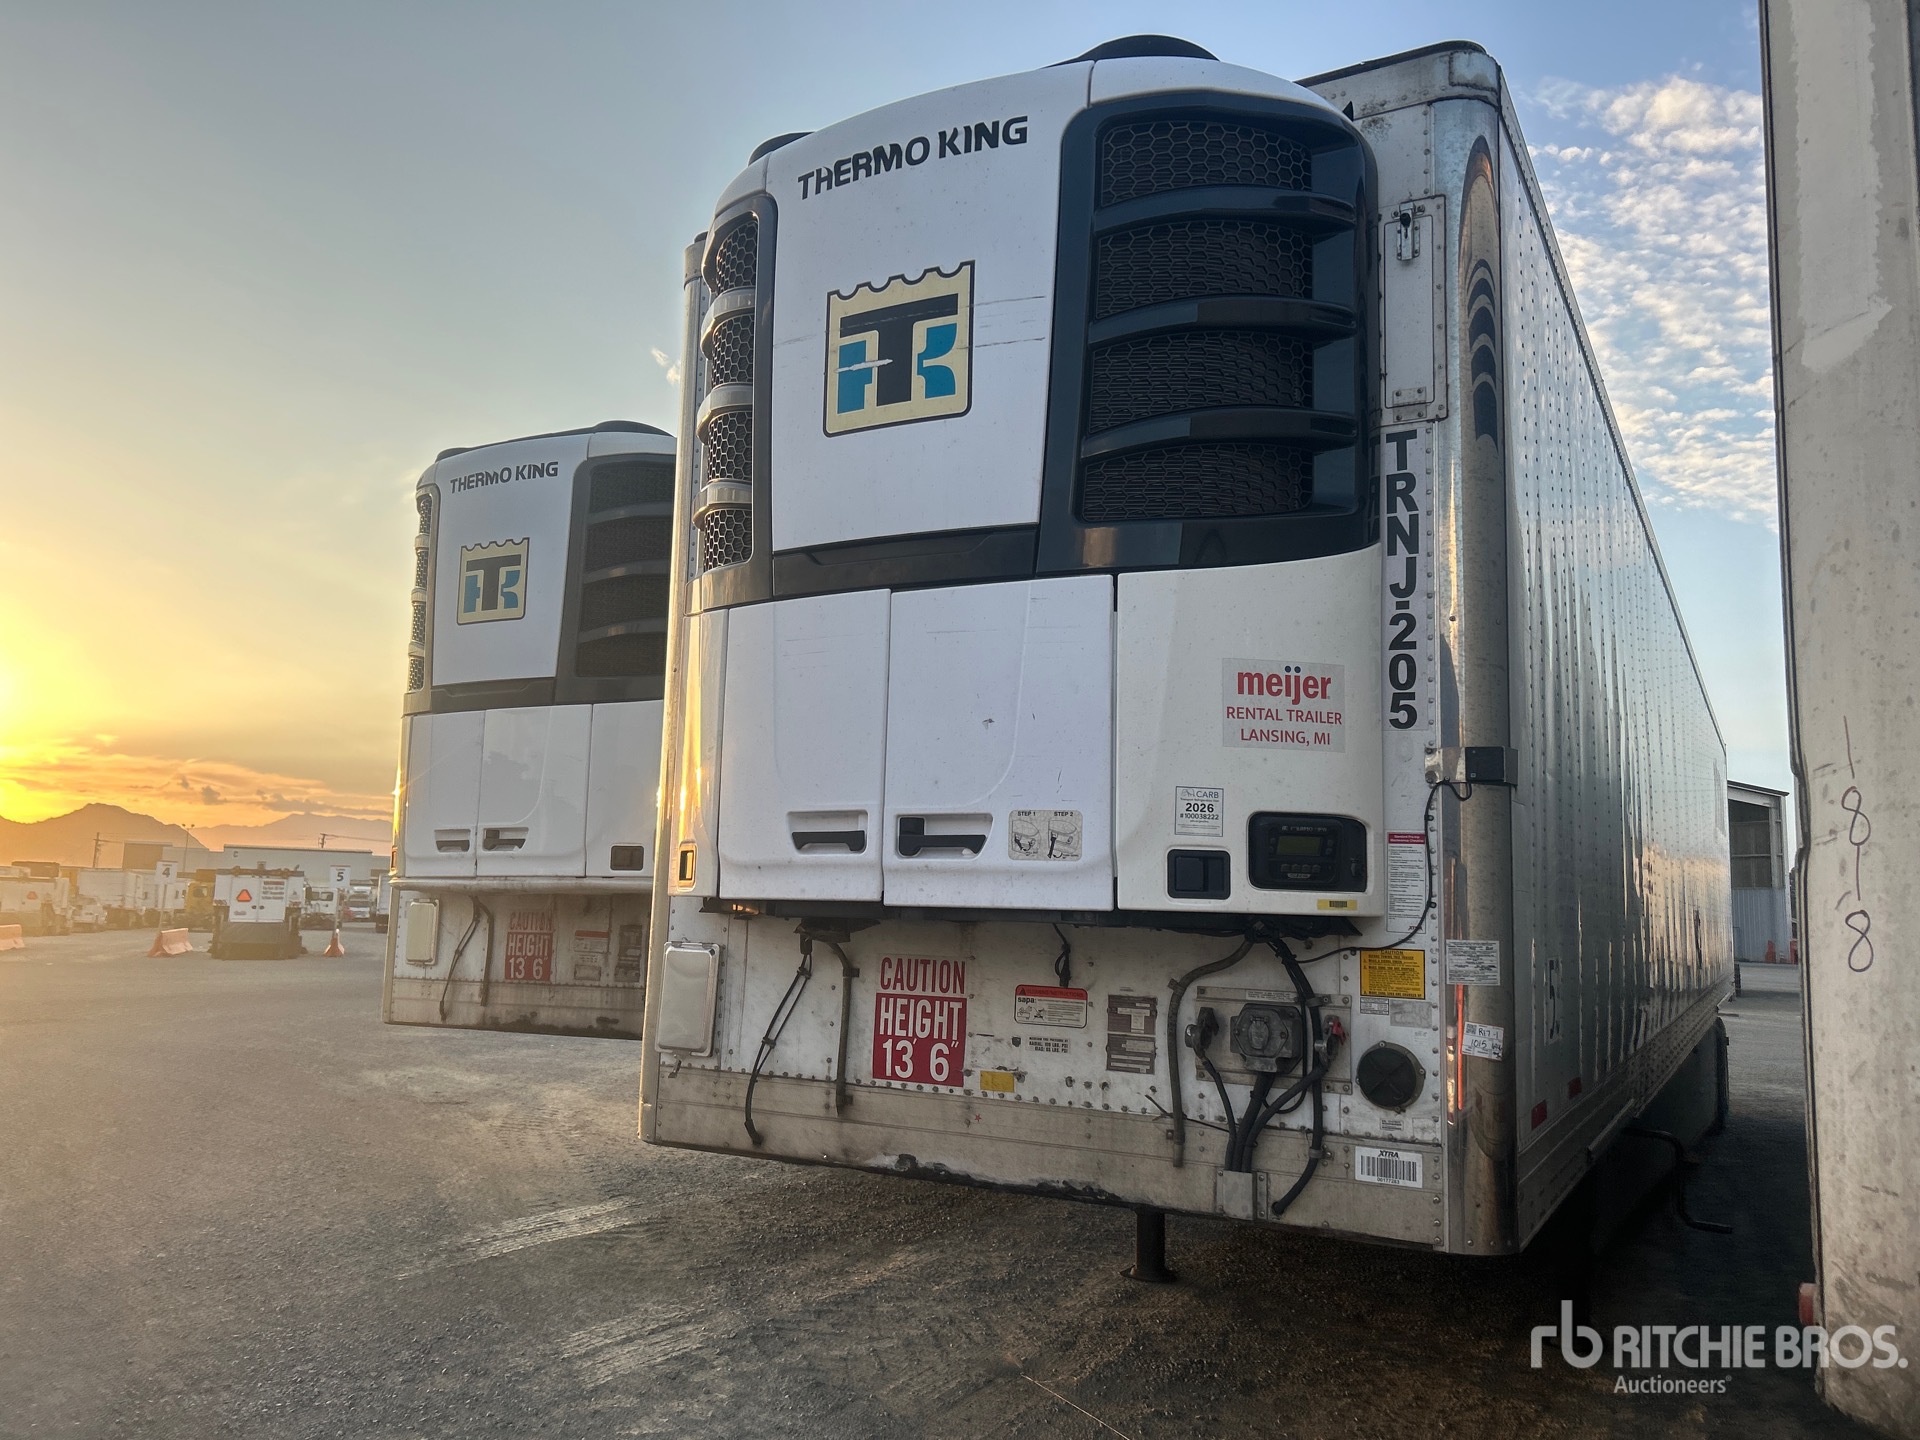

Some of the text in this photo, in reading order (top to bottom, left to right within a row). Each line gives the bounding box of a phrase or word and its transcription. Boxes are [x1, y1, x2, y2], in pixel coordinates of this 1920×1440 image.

[798, 115, 1029, 200] THERMO KING
[450, 461, 559, 494] THERMO KING
[1385, 429, 1420, 730] TRNJ-205
[1237, 665, 1331, 706] meijer
[1226, 706, 1342, 725] RENTAL TRAILER
[1240, 728, 1331, 746] LANSING, MI
[1196, 790, 1219, 798] CARB
[1185, 802, 1214, 813] 2026
[162, 867, 171, 878] 4
[336, 872, 344, 881] 5
[509, 912, 552, 932] CAUTION
[507, 933, 551, 957] HEIGHT
[880, 956, 966, 995] CAUTION
[878, 997, 963, 1041] HEIGHT
[1378, 1150, 1399, 1158] XTRA
